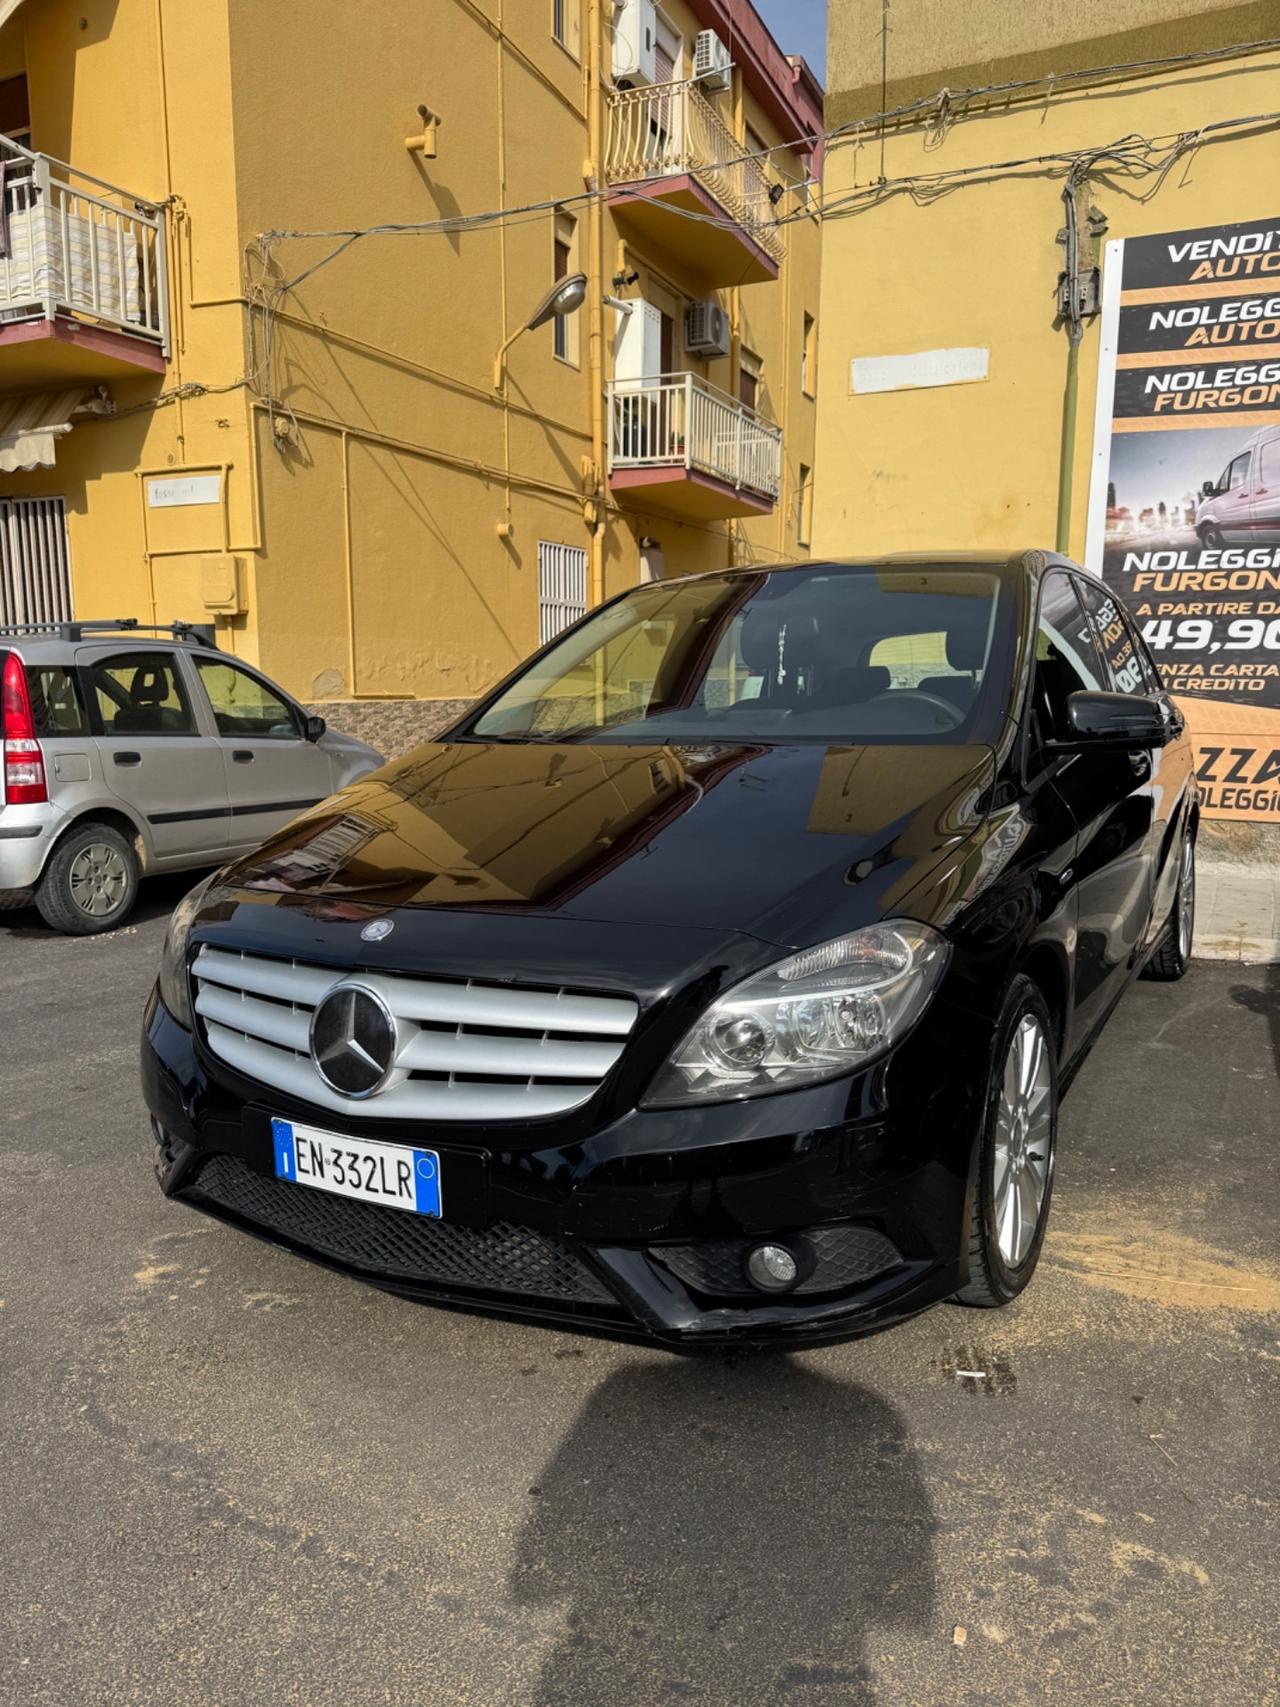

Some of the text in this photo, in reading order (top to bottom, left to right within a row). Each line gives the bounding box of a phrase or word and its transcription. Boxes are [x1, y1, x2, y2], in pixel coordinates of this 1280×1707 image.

[1168, 230, 1280, 263] VENDI
[1188, 251, 1280, 281] AUTO
[1184, 319, 1280, 346] AUTO
[1144, 363, 1280, 394] NOLEGG
[1132, 570, 1280, 592] FURGON
[1136, 604, 1152, 615] A
[1157, 602, 1253, 615] PARTIRE
[1210, 664, 1280, 676] CARTA
[1172, 677, 1265, 691] CREDITO
